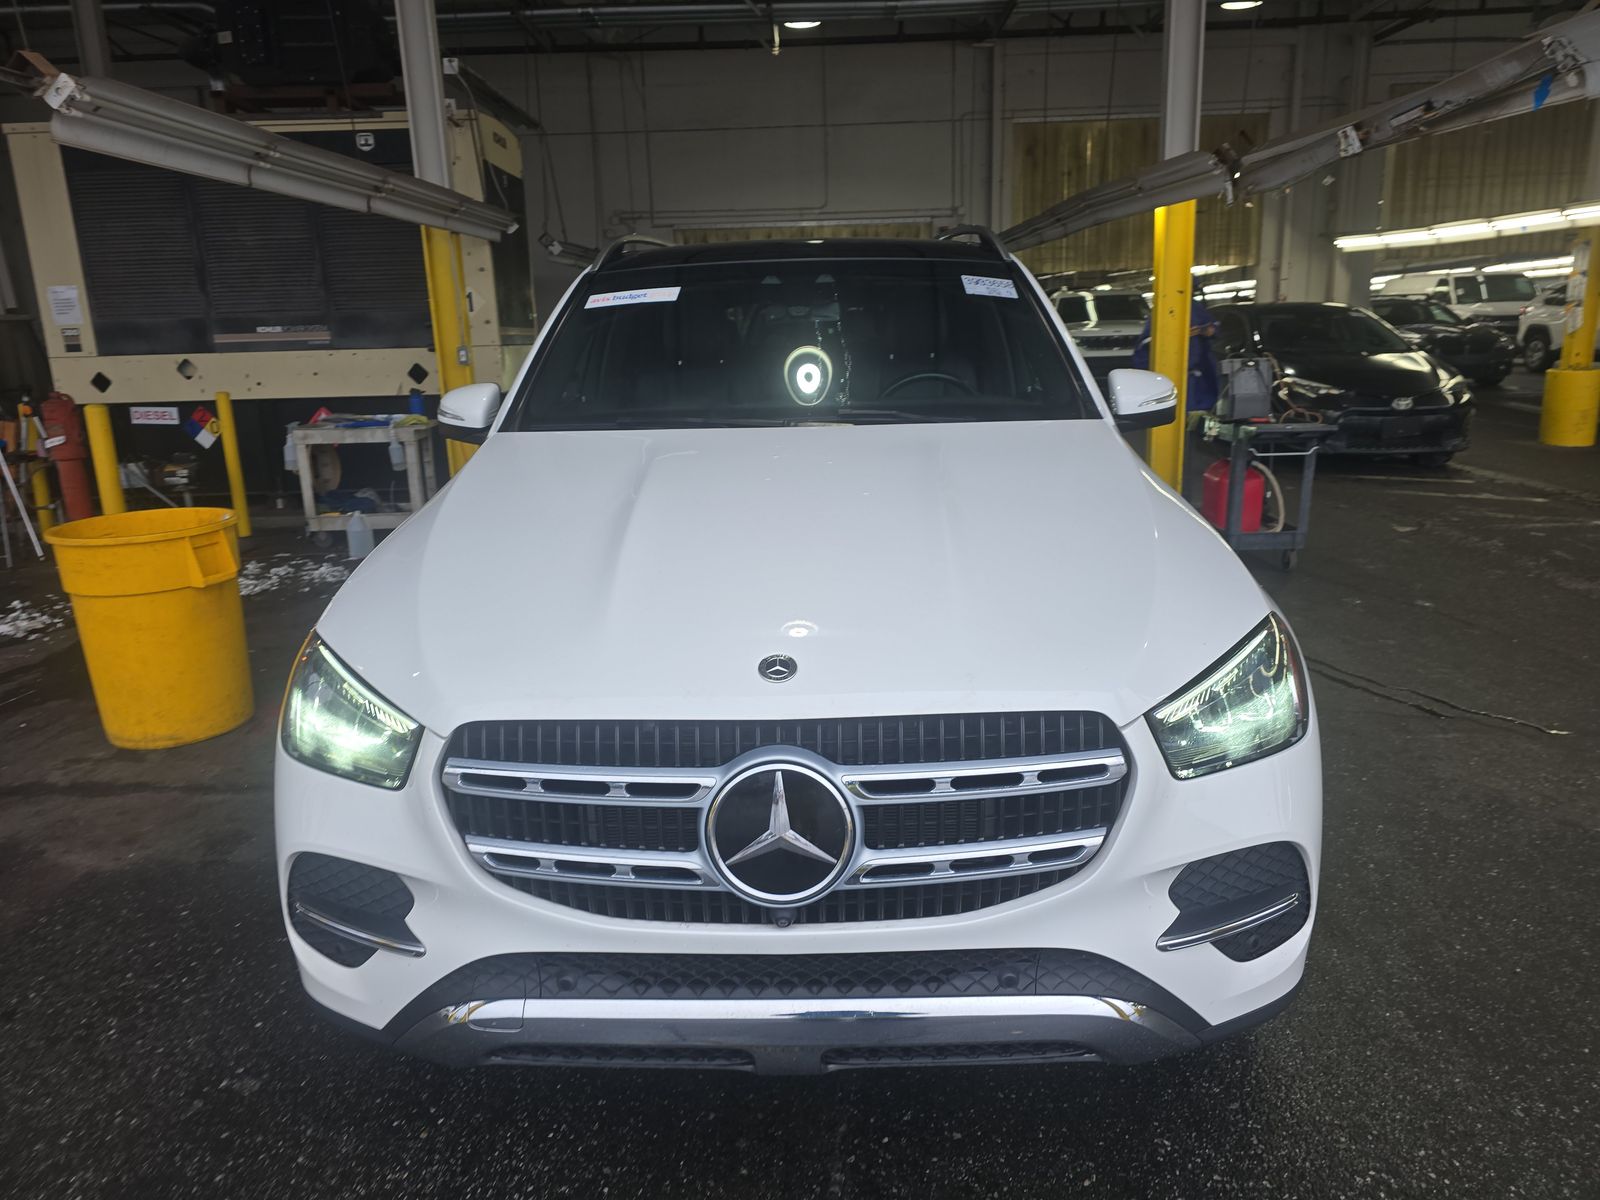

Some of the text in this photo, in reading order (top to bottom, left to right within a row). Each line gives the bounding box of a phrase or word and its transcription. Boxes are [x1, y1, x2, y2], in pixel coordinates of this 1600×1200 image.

[466, 291, 474, 313] 1
[612, 292, 647, 301] budget
[133, 410, 177, 421] DIESEL
